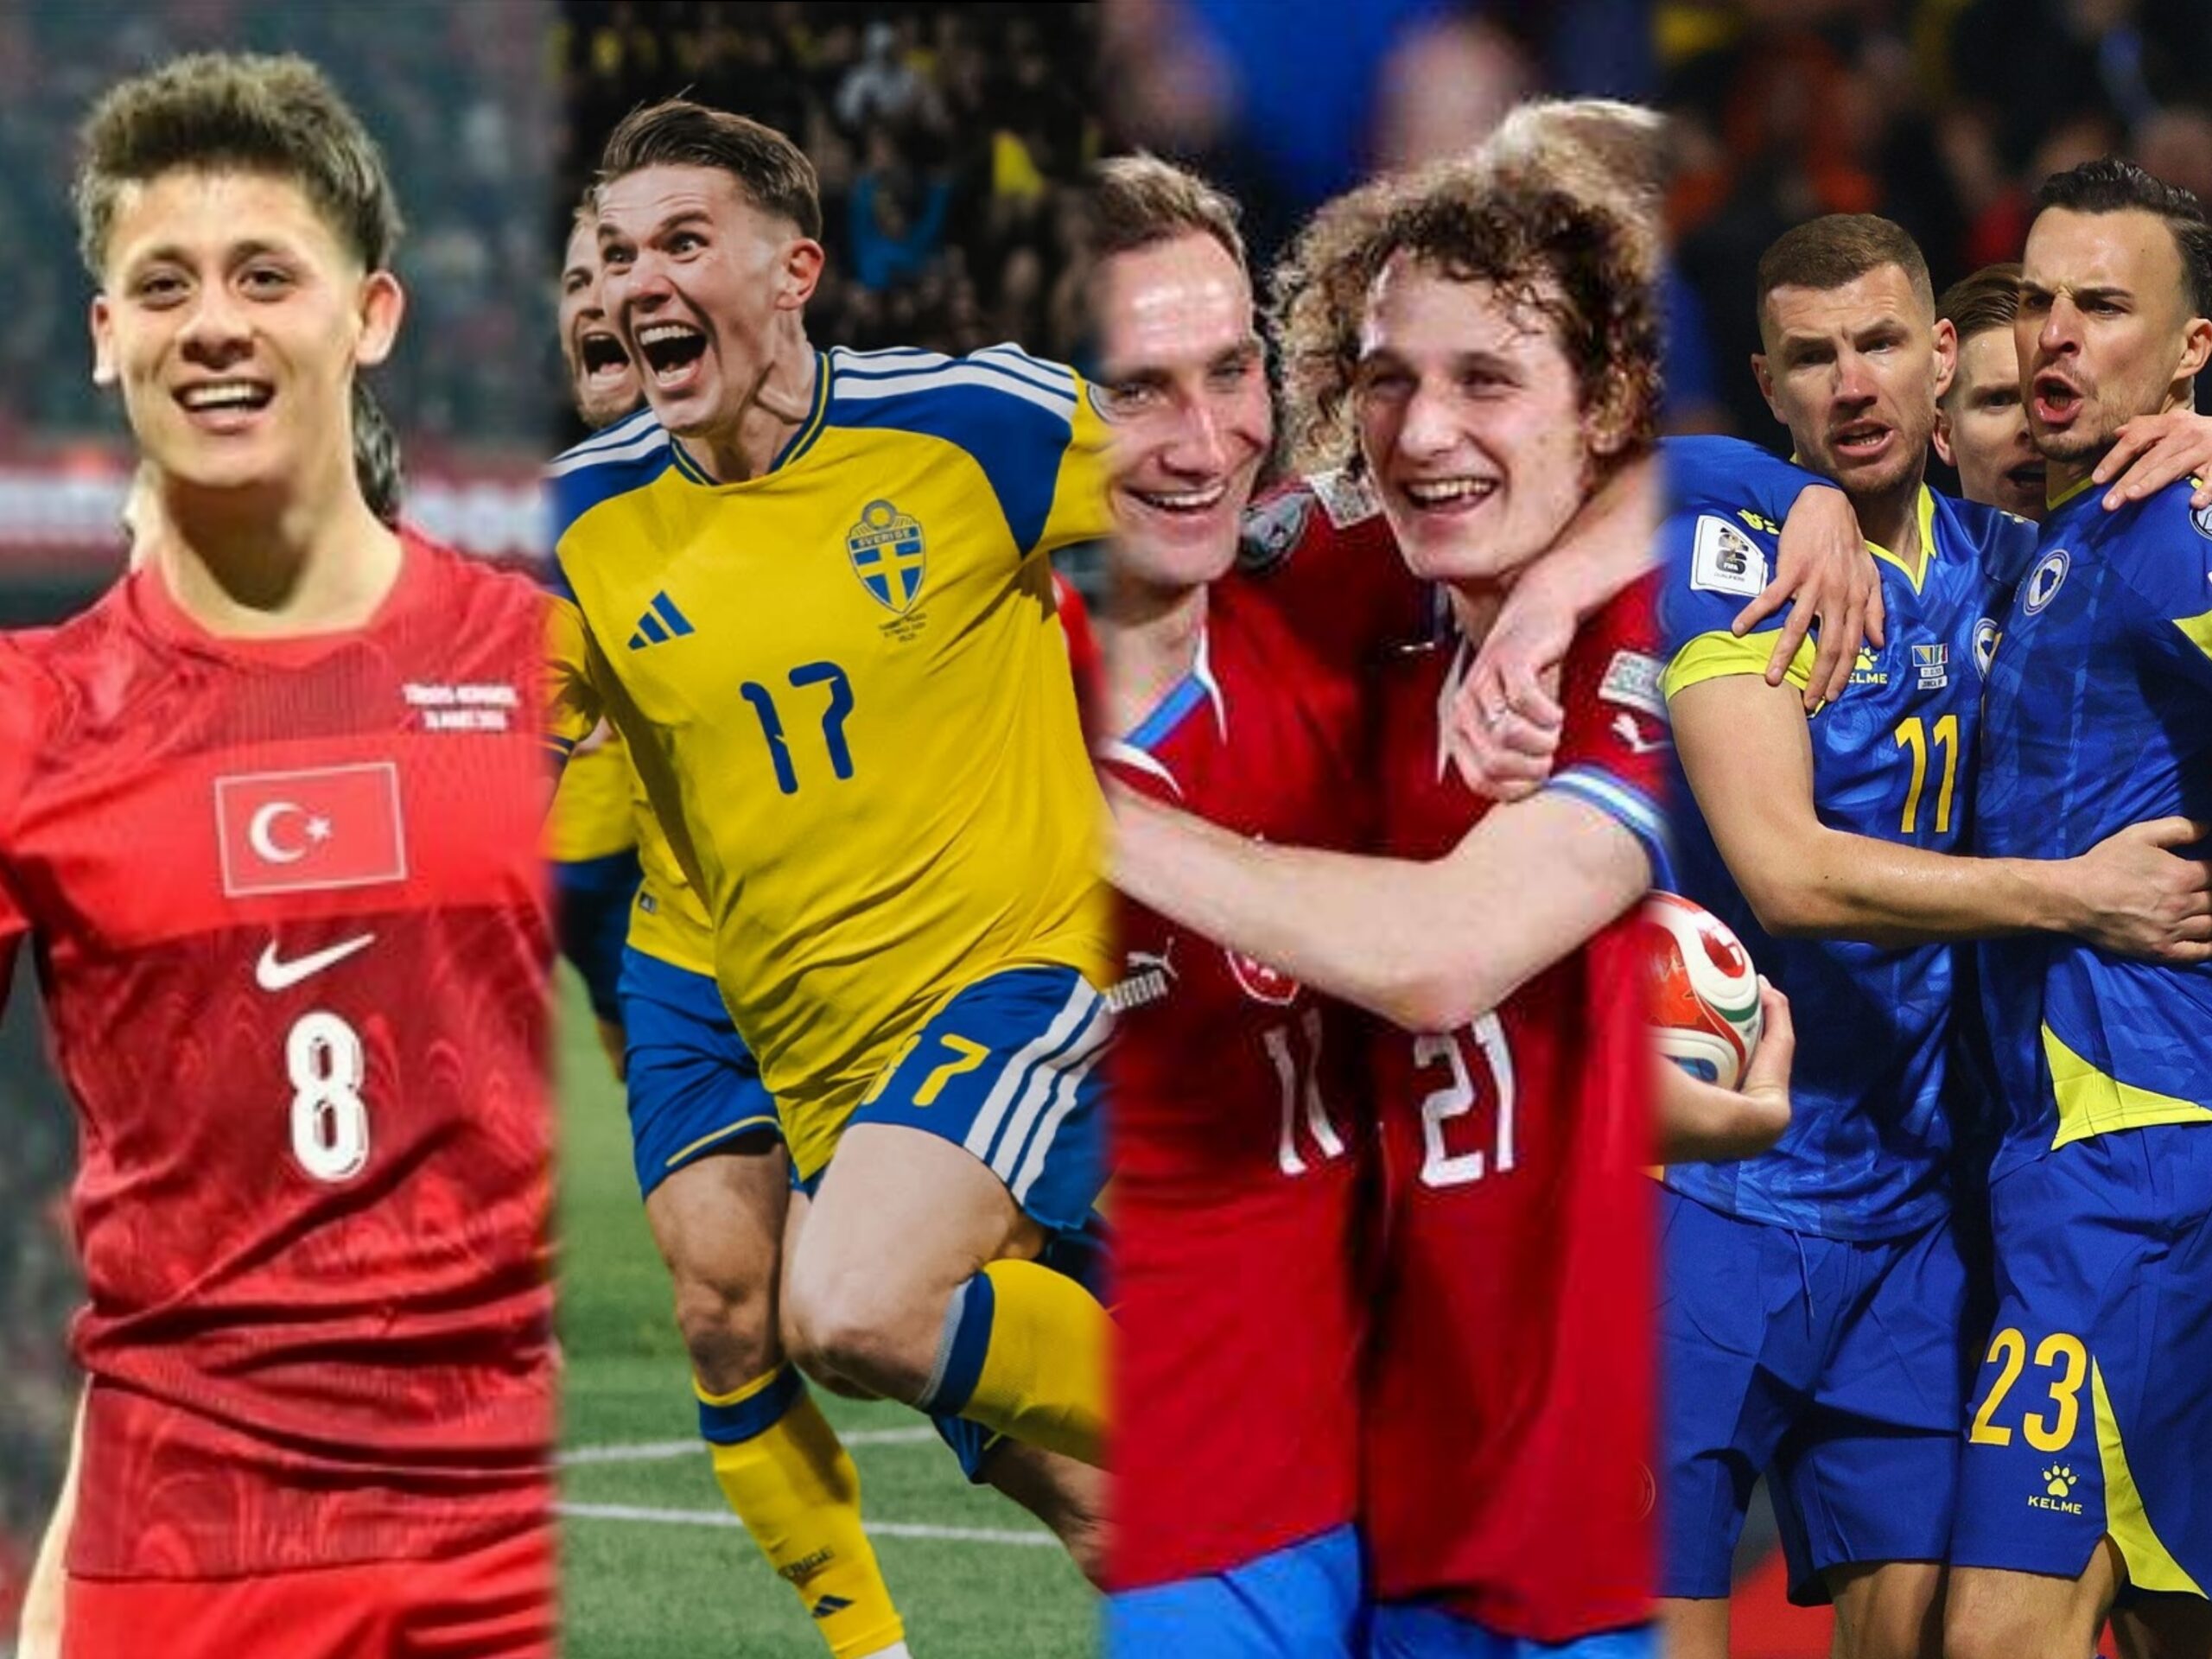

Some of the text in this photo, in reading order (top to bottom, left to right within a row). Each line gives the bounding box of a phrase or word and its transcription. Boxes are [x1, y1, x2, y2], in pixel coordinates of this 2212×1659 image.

[740, 661, 855, 795] 17
[1848, 672, 1888, 684] ELME
[1894, 714, 1959, 833] 11
[286, 1010, 370, 1182] 8
[1414, 1009, 1514, 1188] 21
[1968, 1327, 2088, 1452] 23
[2027, 1495, 2083, 1516] KELME
